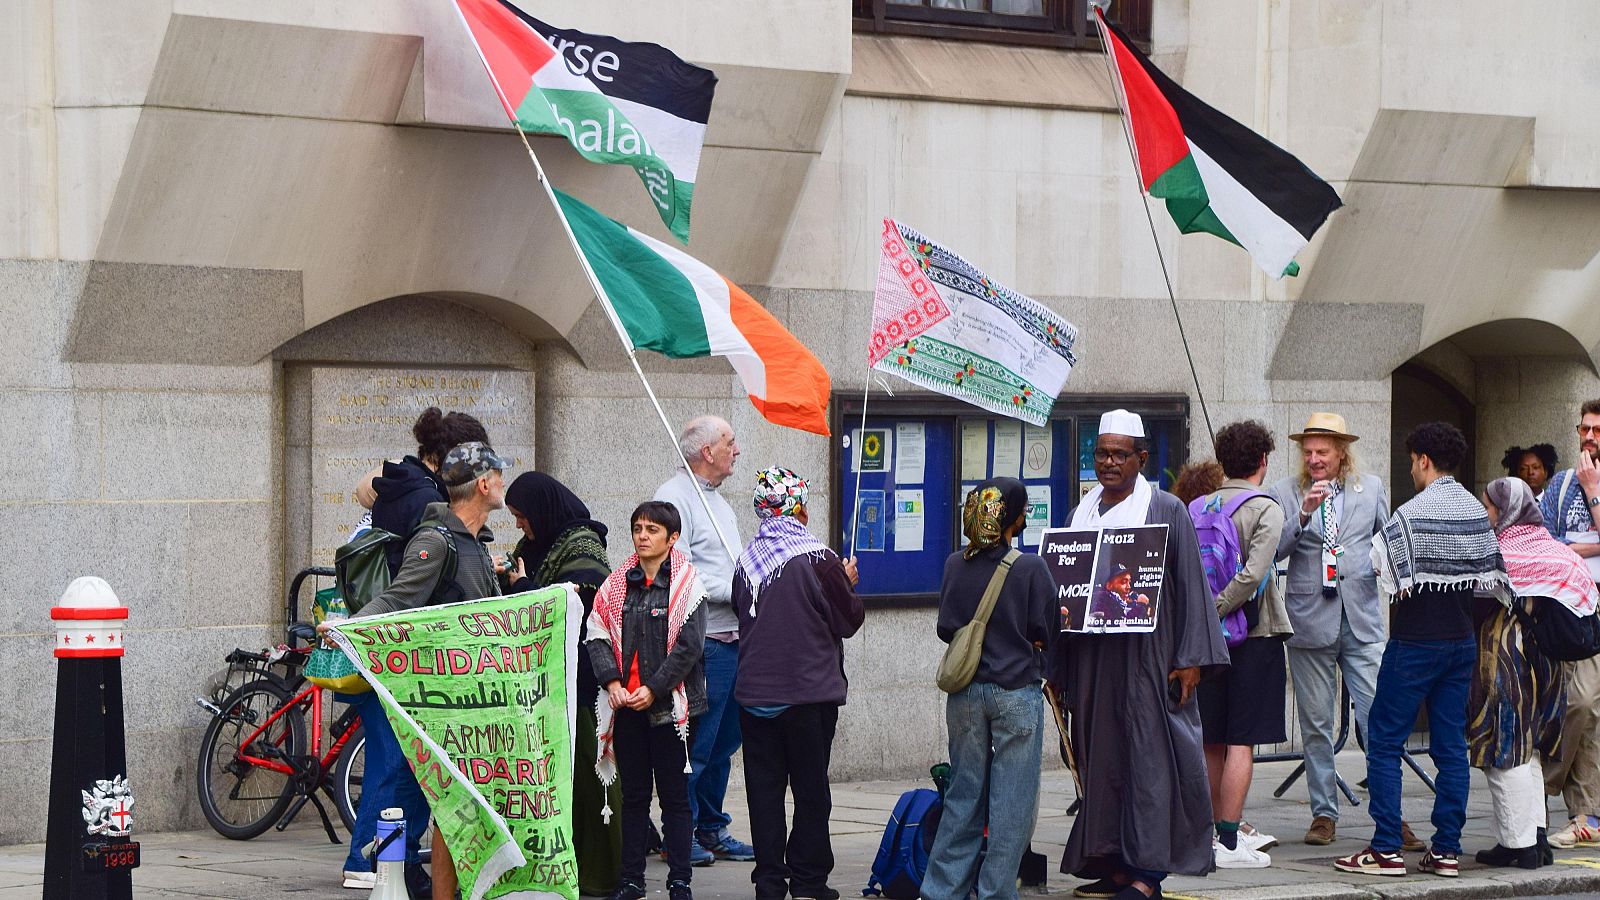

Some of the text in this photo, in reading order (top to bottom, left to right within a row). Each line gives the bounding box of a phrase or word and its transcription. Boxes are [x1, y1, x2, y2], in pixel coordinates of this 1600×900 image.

[396, 375, 435, 389] STONE
[440, 376, 481, 390] BELOW
[339, 393, 368, 407] HAD
[373, 394, 388, 407] TO
[327, 457, 393, 467] CORPORATI
[322, 492, 344, 504] THE
[1102, 534, 1135, 544] MOIZ
[1046, 541, 1092, 553] Freedom
[1058, 555, 1077, 566] For
[1139, 573, 1162, 581] rights
[1058, 583, 1090, 599] MOIZ
[354, 597, 556, 645] STOP THE GENOCIDE
[1113, 617, 1152, 625] criminal
[368, 635, 550, 675] SOLIDARITY
[389, 681, 507, 716] لفلسطي
[442, 722, 515, 754] ARMING
